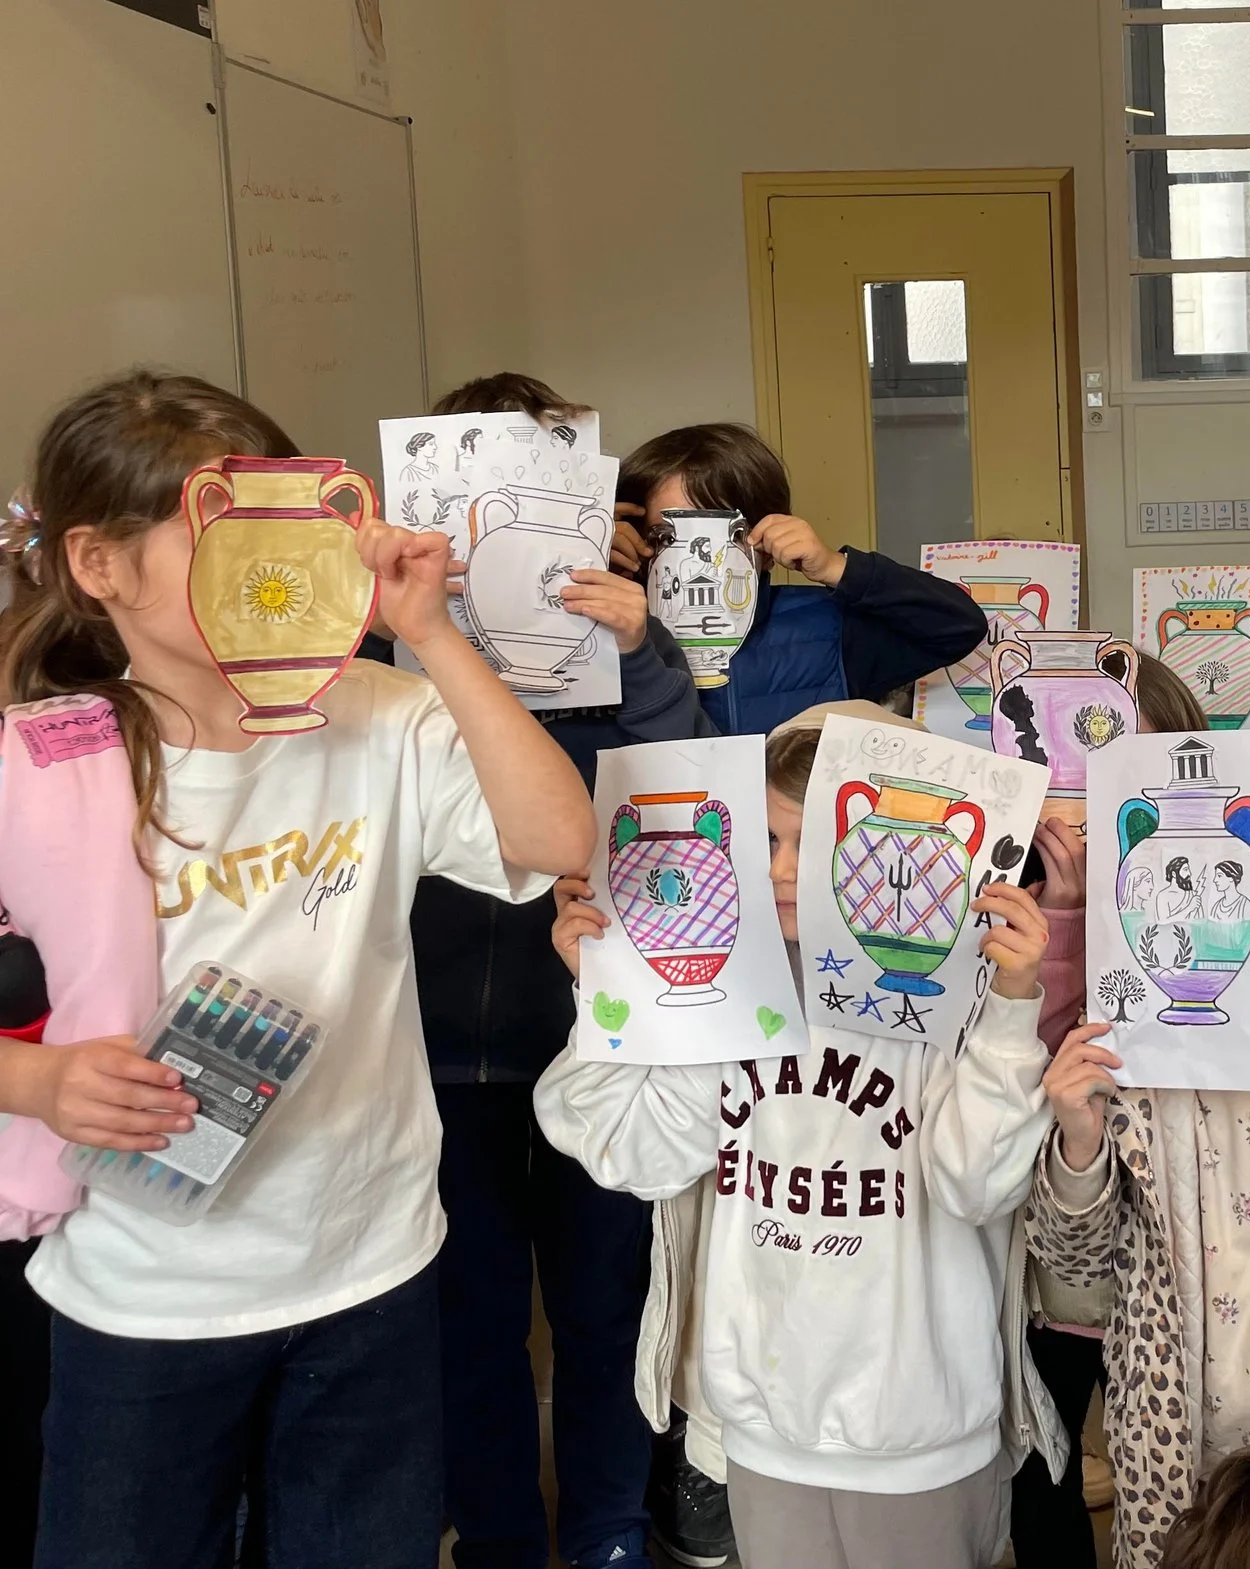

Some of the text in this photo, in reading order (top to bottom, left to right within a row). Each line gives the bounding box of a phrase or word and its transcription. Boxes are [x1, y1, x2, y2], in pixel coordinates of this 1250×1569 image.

[1146, 507, 1153, 516] 0
[1166, 506, 1171, 516] 1
[1184, 505, 1190, 515] 2
[1202, 505, 1208, 514] 3
[1220, 504, 1227, 513] 4
[1240, 504, 1247, 513] 5
[302, 863, 357, 931] Gold
[716, 1139, 905, 1218] ÉLYSÉES
[751, 1219, 862, 1257] Paris 1970
